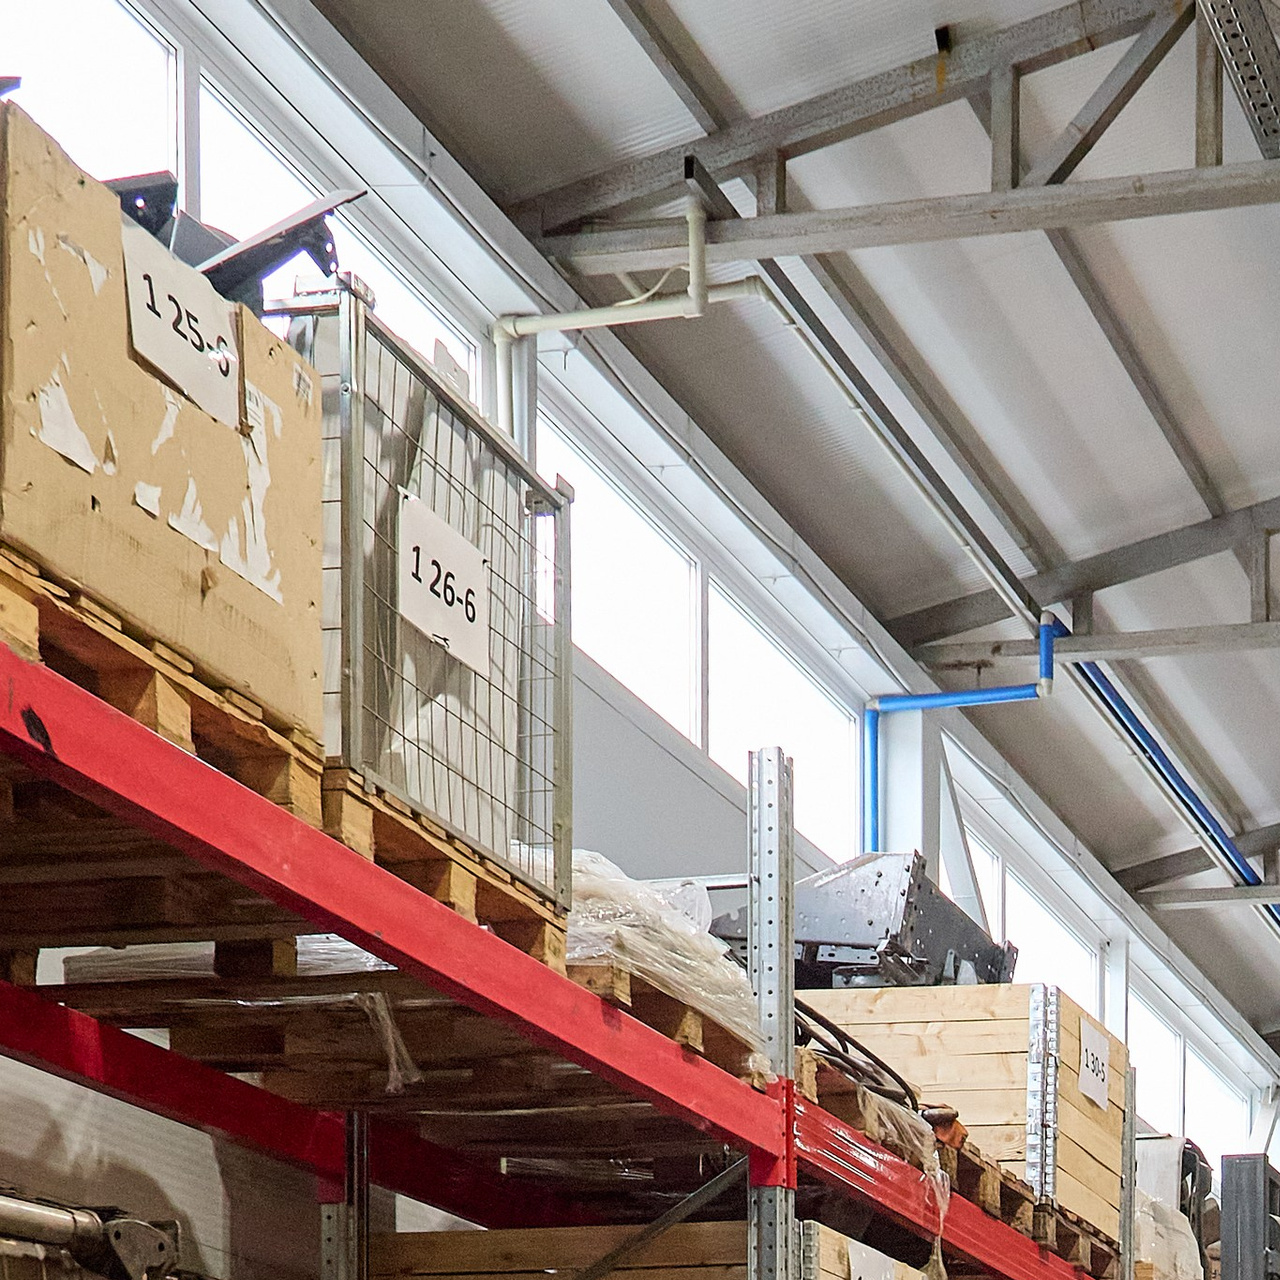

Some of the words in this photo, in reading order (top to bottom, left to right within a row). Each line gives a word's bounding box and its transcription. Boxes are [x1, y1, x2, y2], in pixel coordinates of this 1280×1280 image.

[142, 273, 162, 319] 1
[411, 545, 422, 584] 1
[429, 559, 476, 623] 26-6
